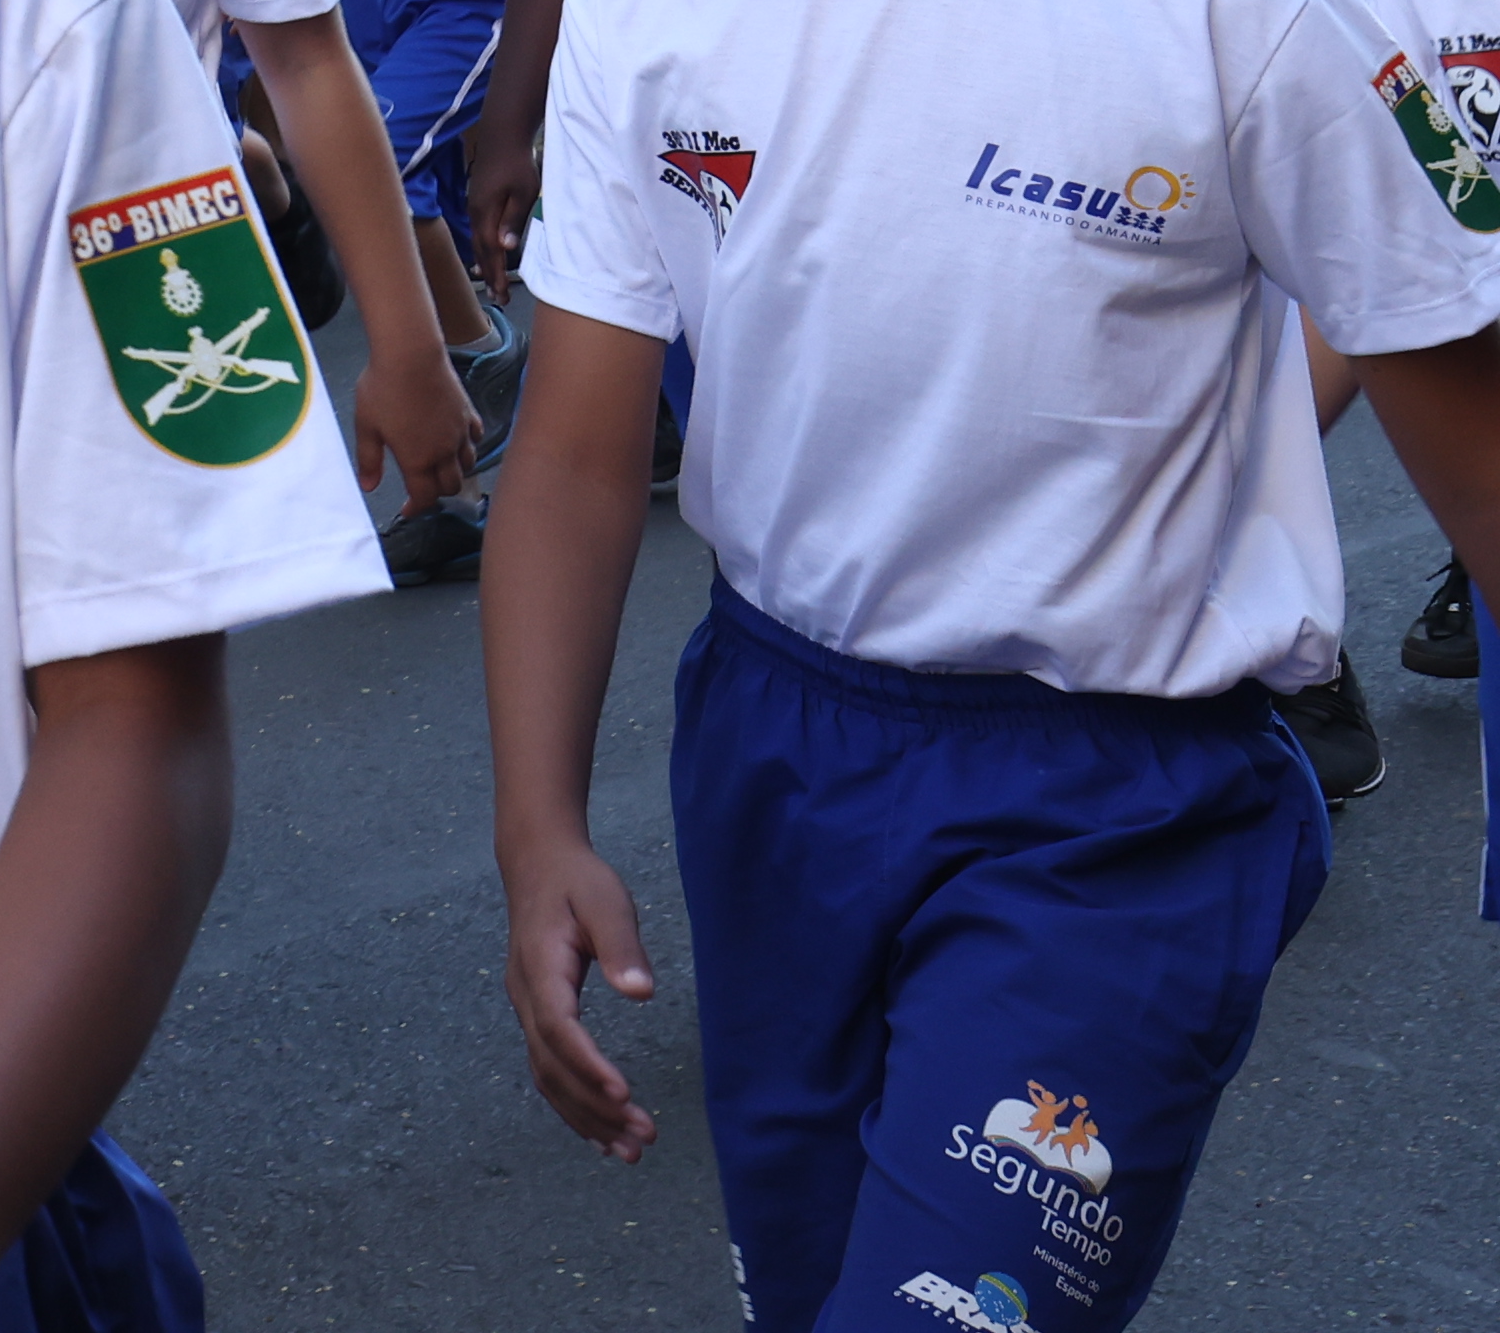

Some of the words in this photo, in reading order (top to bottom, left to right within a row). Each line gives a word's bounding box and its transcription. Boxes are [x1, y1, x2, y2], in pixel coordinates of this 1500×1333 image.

[966, 143, 1120, 219] Icasu
[72, 212, 123, 259] 36º
[126, 179, 239, 244] BIMEC
[965, 194, 1075, 227] PREPARANDO
[1080, 220, 1090, 230] O
[1095, 223, 1162, 247] AMANHÃ
[945, 1123, 1124, 1242] Segundo
[1033, 1244, 1091, 1284] Ministério
[1041, 1204, 1112, 1267] Tempo
[1055, 1275, 1094, 1308] Esporte
